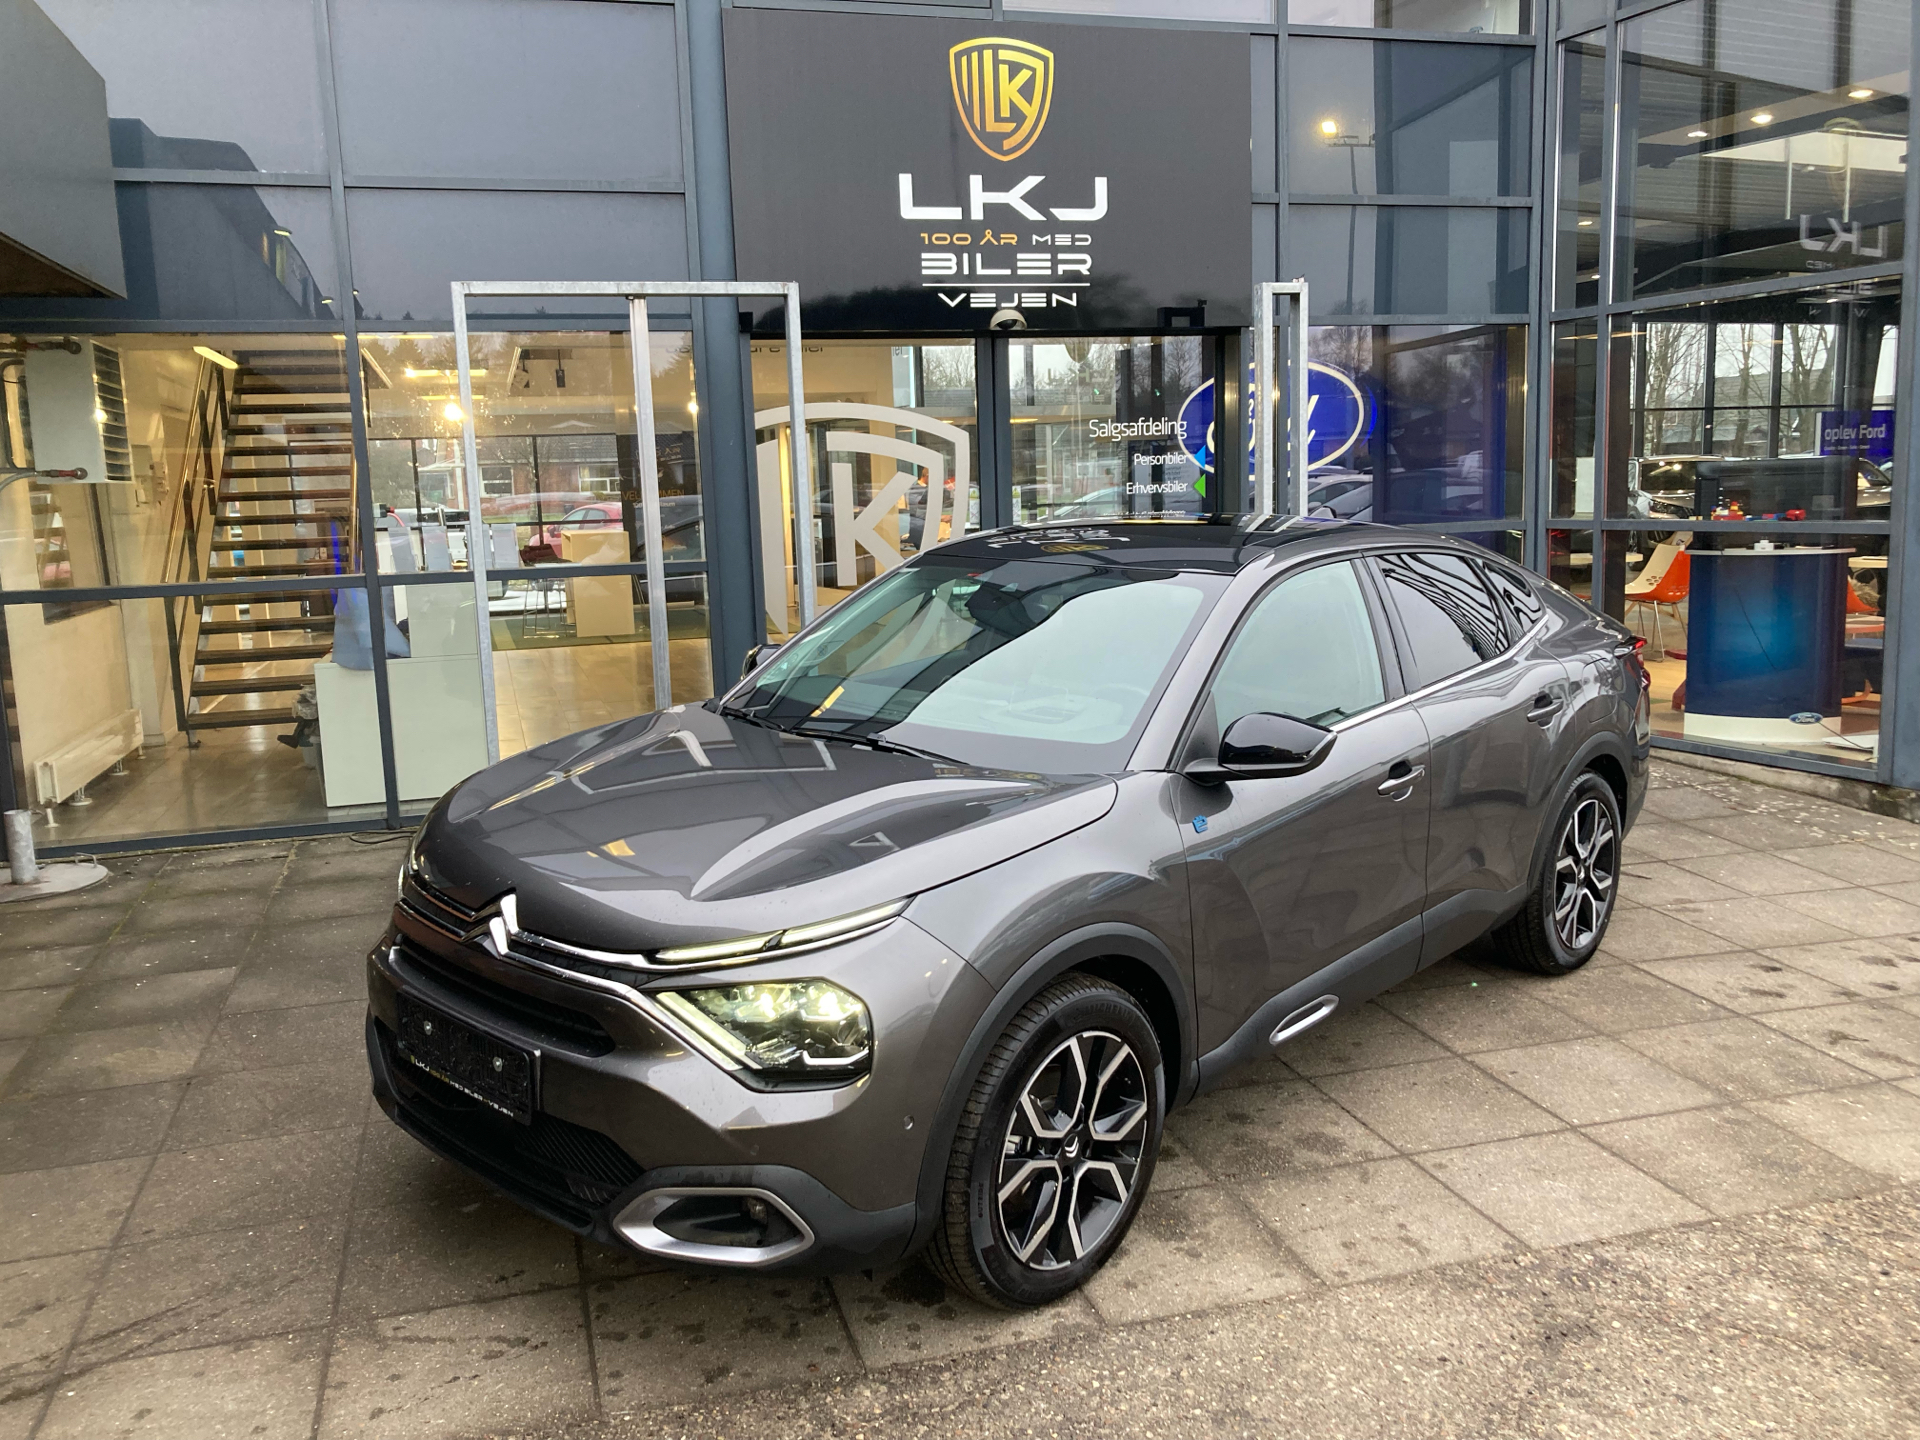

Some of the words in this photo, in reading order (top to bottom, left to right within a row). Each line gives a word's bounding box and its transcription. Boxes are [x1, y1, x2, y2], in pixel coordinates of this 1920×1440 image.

[898, 173, 1109, 221] LKJ
[920, 232, 972, 245] 100
[979, 229, 1018, 246] ÅR
[1032, 233, 1092, 246] MED
[920, 252, 1093, 275] BILER
[937, 292, 1078, 308] VEJEN
[1088, 416, 1188, 442] Salgsafdeling
[1824, 424, 1857, 443] oplev
[1858, 423, 1887, 439] Ford
[1133, 451, 1188, 466] Personbiler
[1125, 480, 1188, 495] Erhvervsbiler
